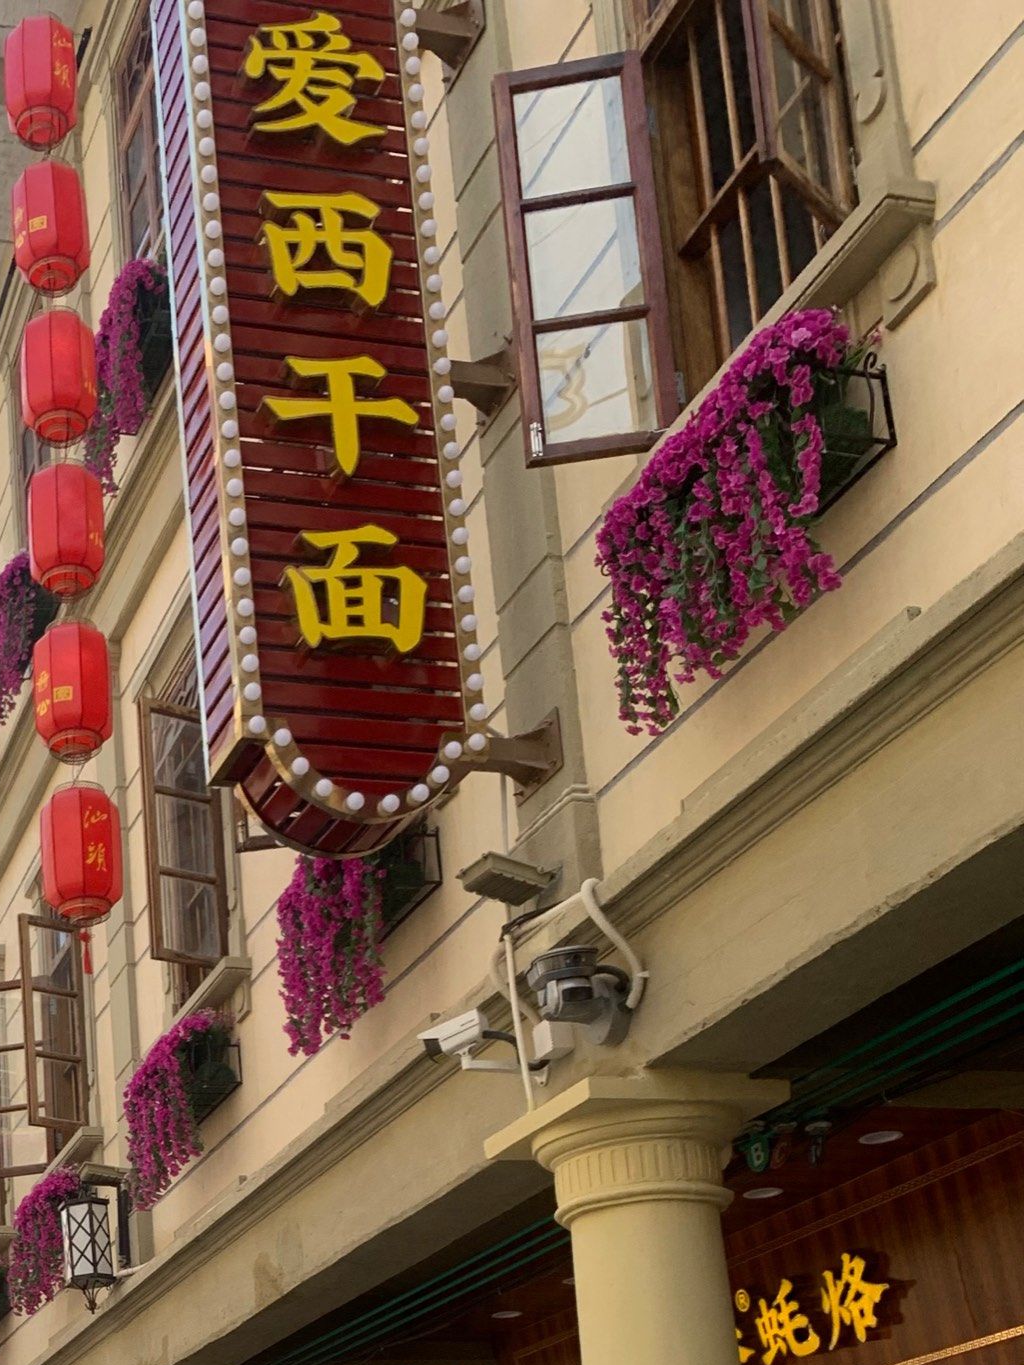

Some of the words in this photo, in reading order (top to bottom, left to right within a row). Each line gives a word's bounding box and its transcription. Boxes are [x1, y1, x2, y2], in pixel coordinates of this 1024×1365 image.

[244, 11, 428, 652] 爱西干面
[83, 805, 109, 872] 汕頭
